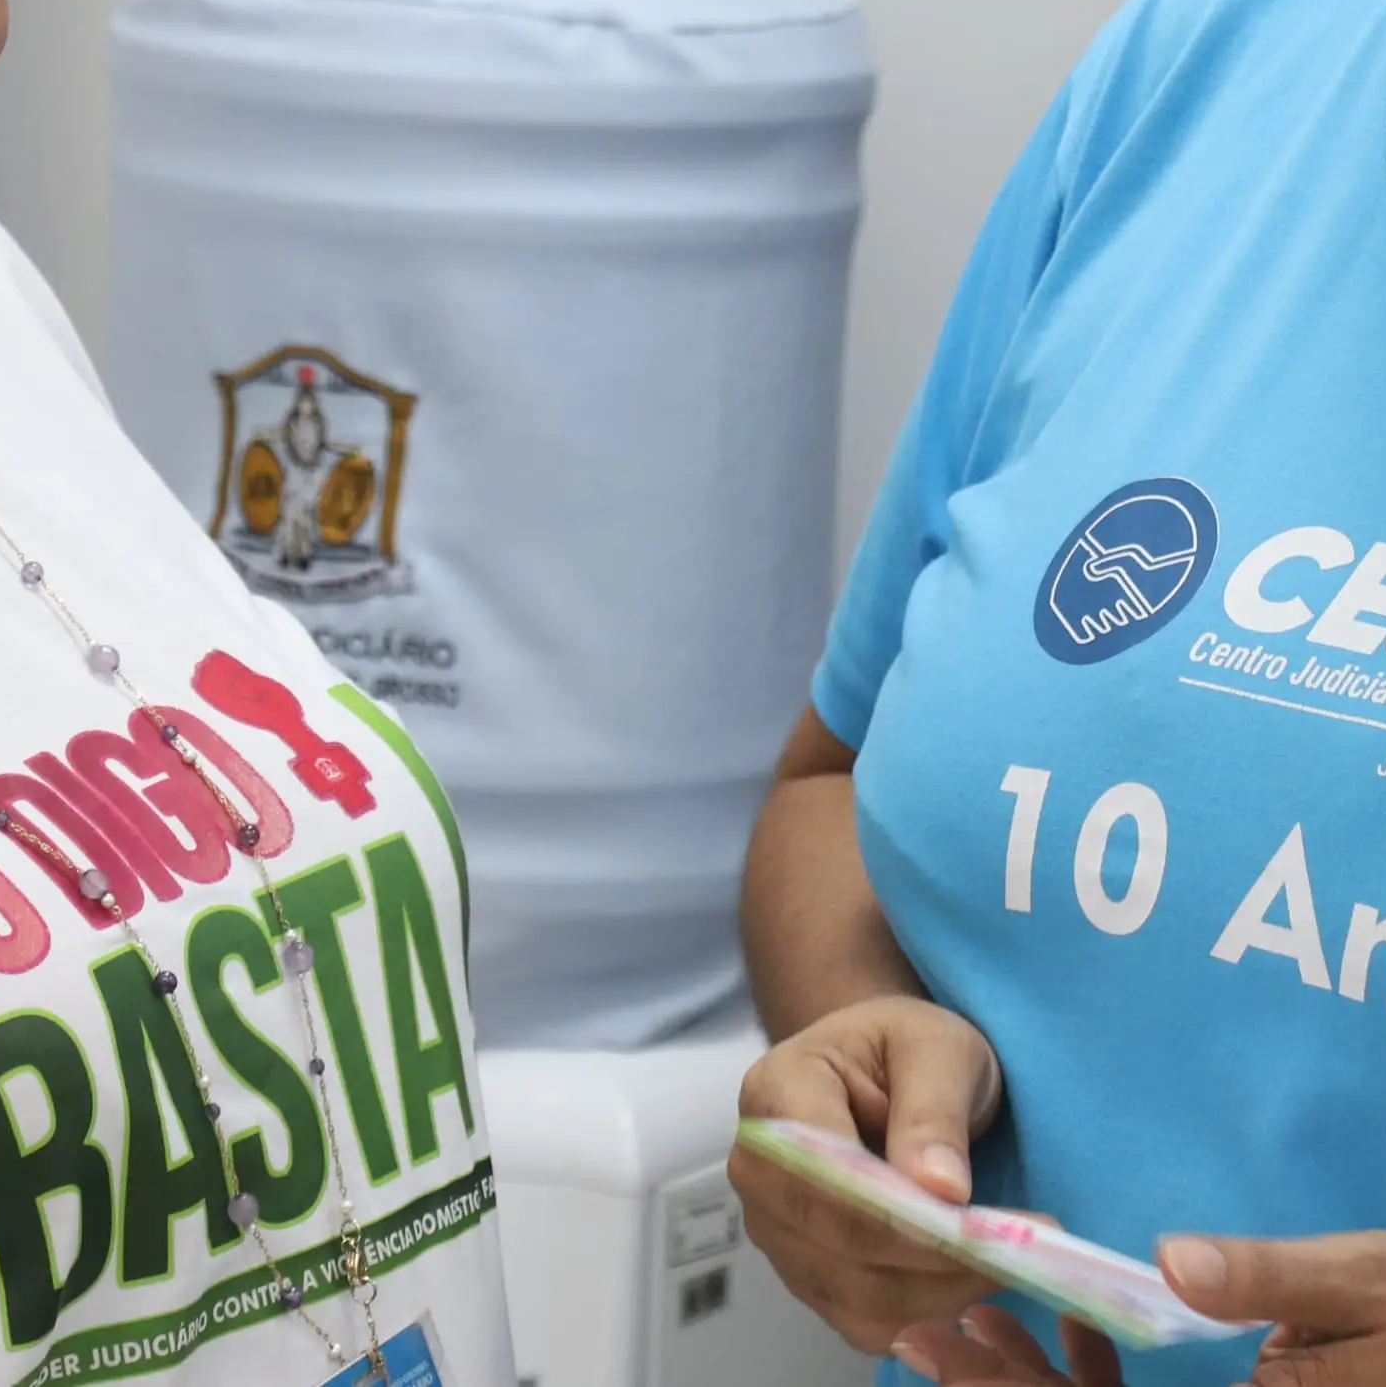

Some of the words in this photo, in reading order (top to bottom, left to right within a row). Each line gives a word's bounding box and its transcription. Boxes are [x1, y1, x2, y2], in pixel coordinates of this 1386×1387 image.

[1189, 632, 1288, 680] Centro
[1000, 764, 1168, 935] 10
[89, 1311, 208, 1371] JUDICIÁRIO
[303, 1269, 318, 1293] A
[320, 1229, 414, 1283] VIOÊNCIA
